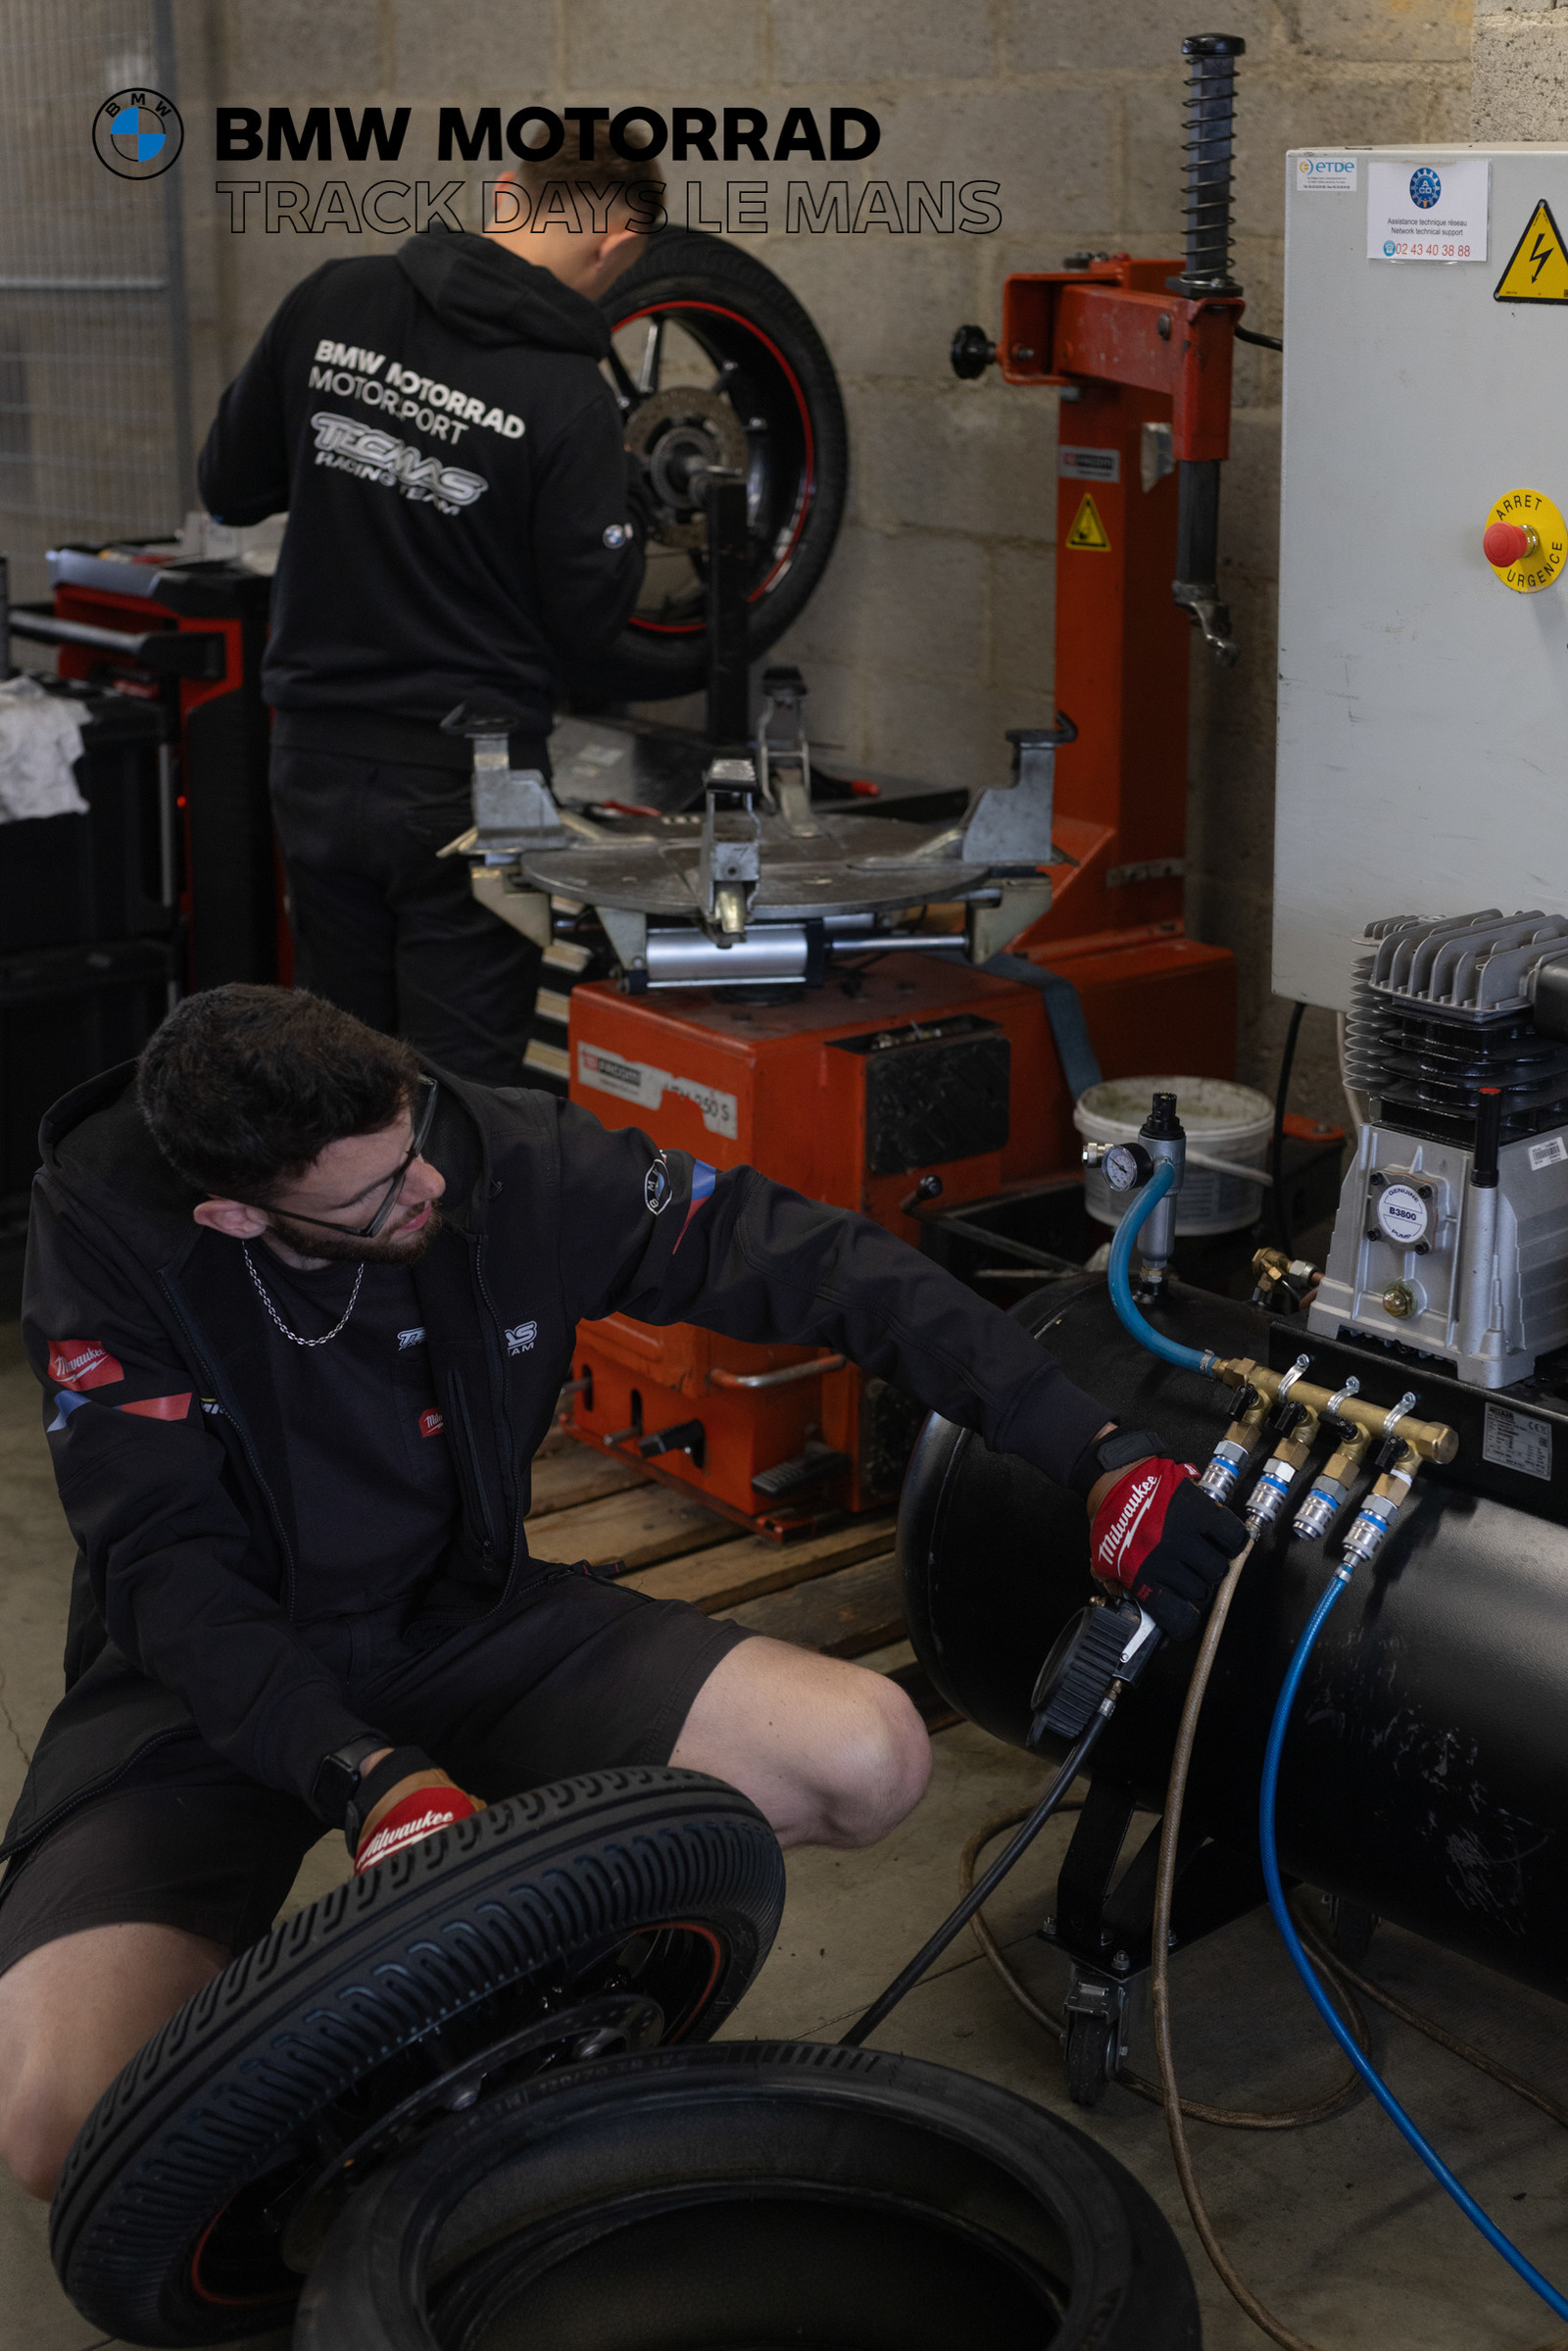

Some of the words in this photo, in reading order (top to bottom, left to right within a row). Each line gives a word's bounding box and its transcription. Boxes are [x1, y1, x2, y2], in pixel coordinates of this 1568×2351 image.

[1391, 226, 1414, 235] Network
[1442, 228, 1463, 237] support
[1396, 243, 1408, 255] 02
[1410, 243, 1423, 256] 43
[1426, 244, 1439, 257] 40
[1442, 244, 1454, 257] 38
[1457, 245, 1470, 257] 88
[314, 339, 386, 375] BMW
[385, 362, 525, 439] MOTORRAD
[315, 451, 396, 486] RACING
[1495, 494, 1543, 521] ARRET
[1506, 541, 1563, 588] URGENCE
[1388, 1187, 1419, 1203] GENUINE
[1389, 1206, 1416, 1221] B3800
[1392, 1228, 1411, 1240] PUMP
[1098, 1474, 1158, 1566] Milwaukee
[357, 1810, 455, 1870] Milwaukee
